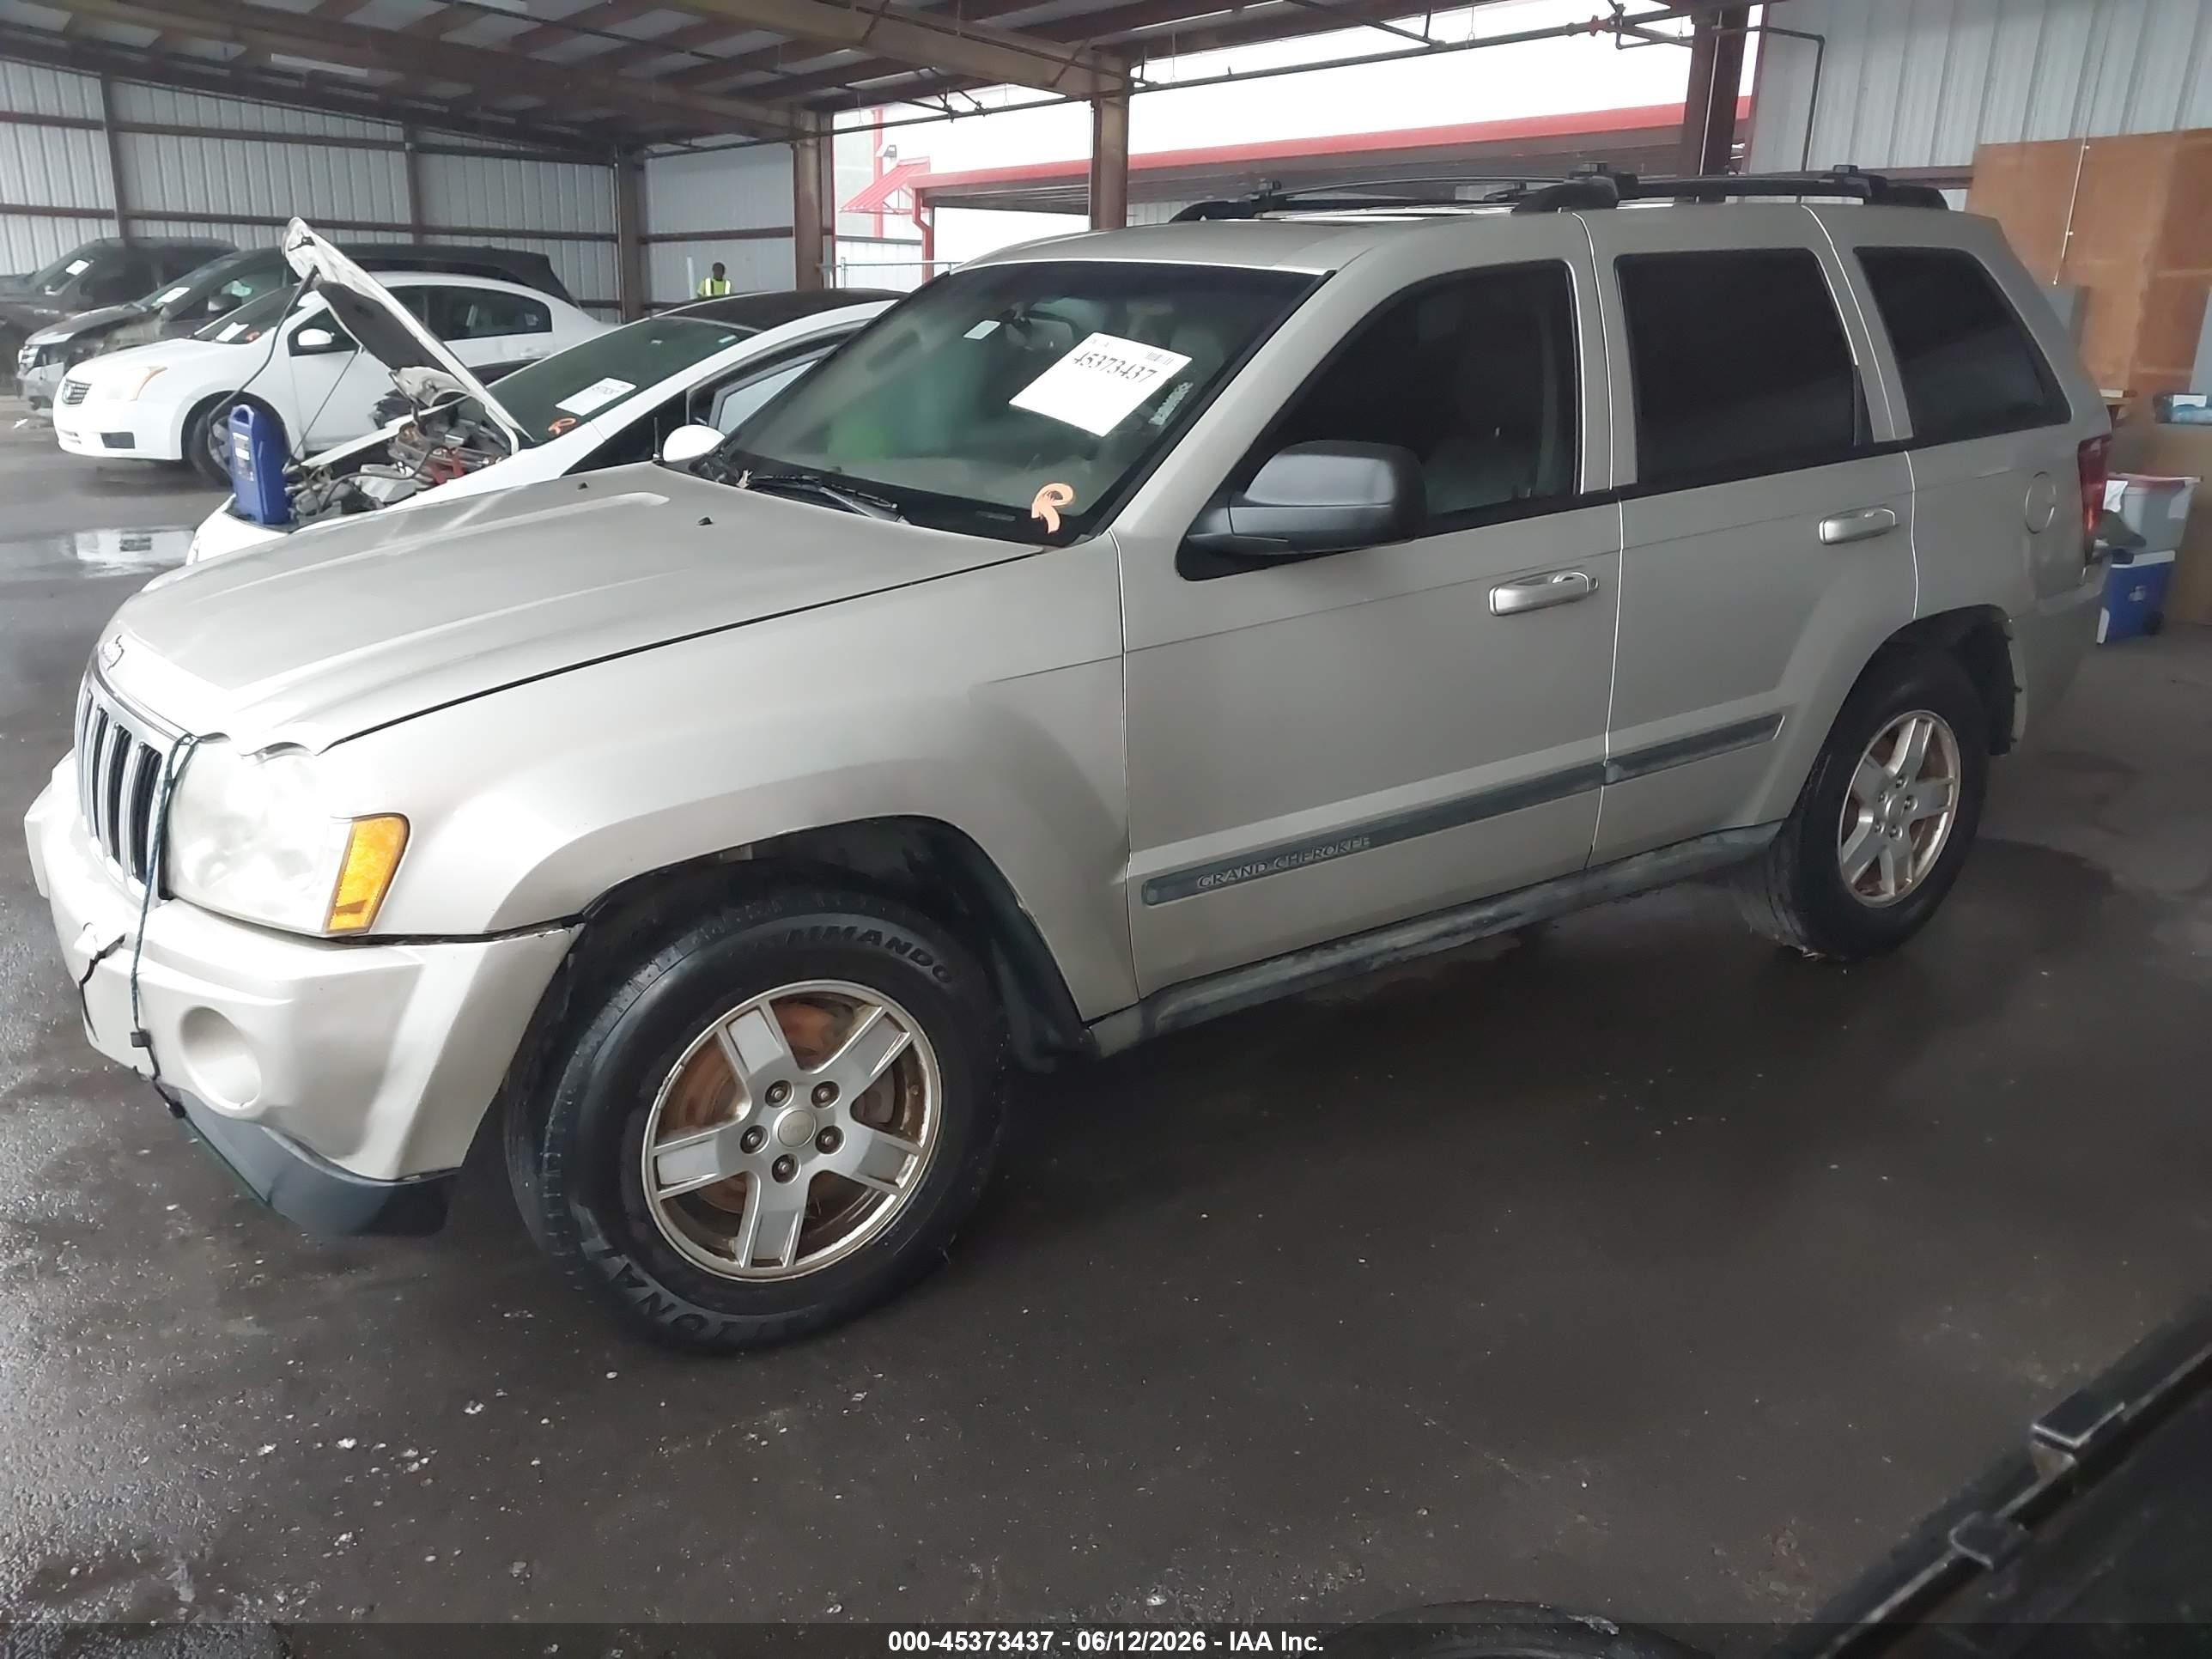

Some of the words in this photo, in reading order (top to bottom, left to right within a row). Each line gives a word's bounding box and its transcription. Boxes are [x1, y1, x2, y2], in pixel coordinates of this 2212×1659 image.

[1073, 350, 1158, 383] 45373437
[1197, 861, 1268, 888] GRAND
[1273, 836, 1371, 870] CHEROKEE
